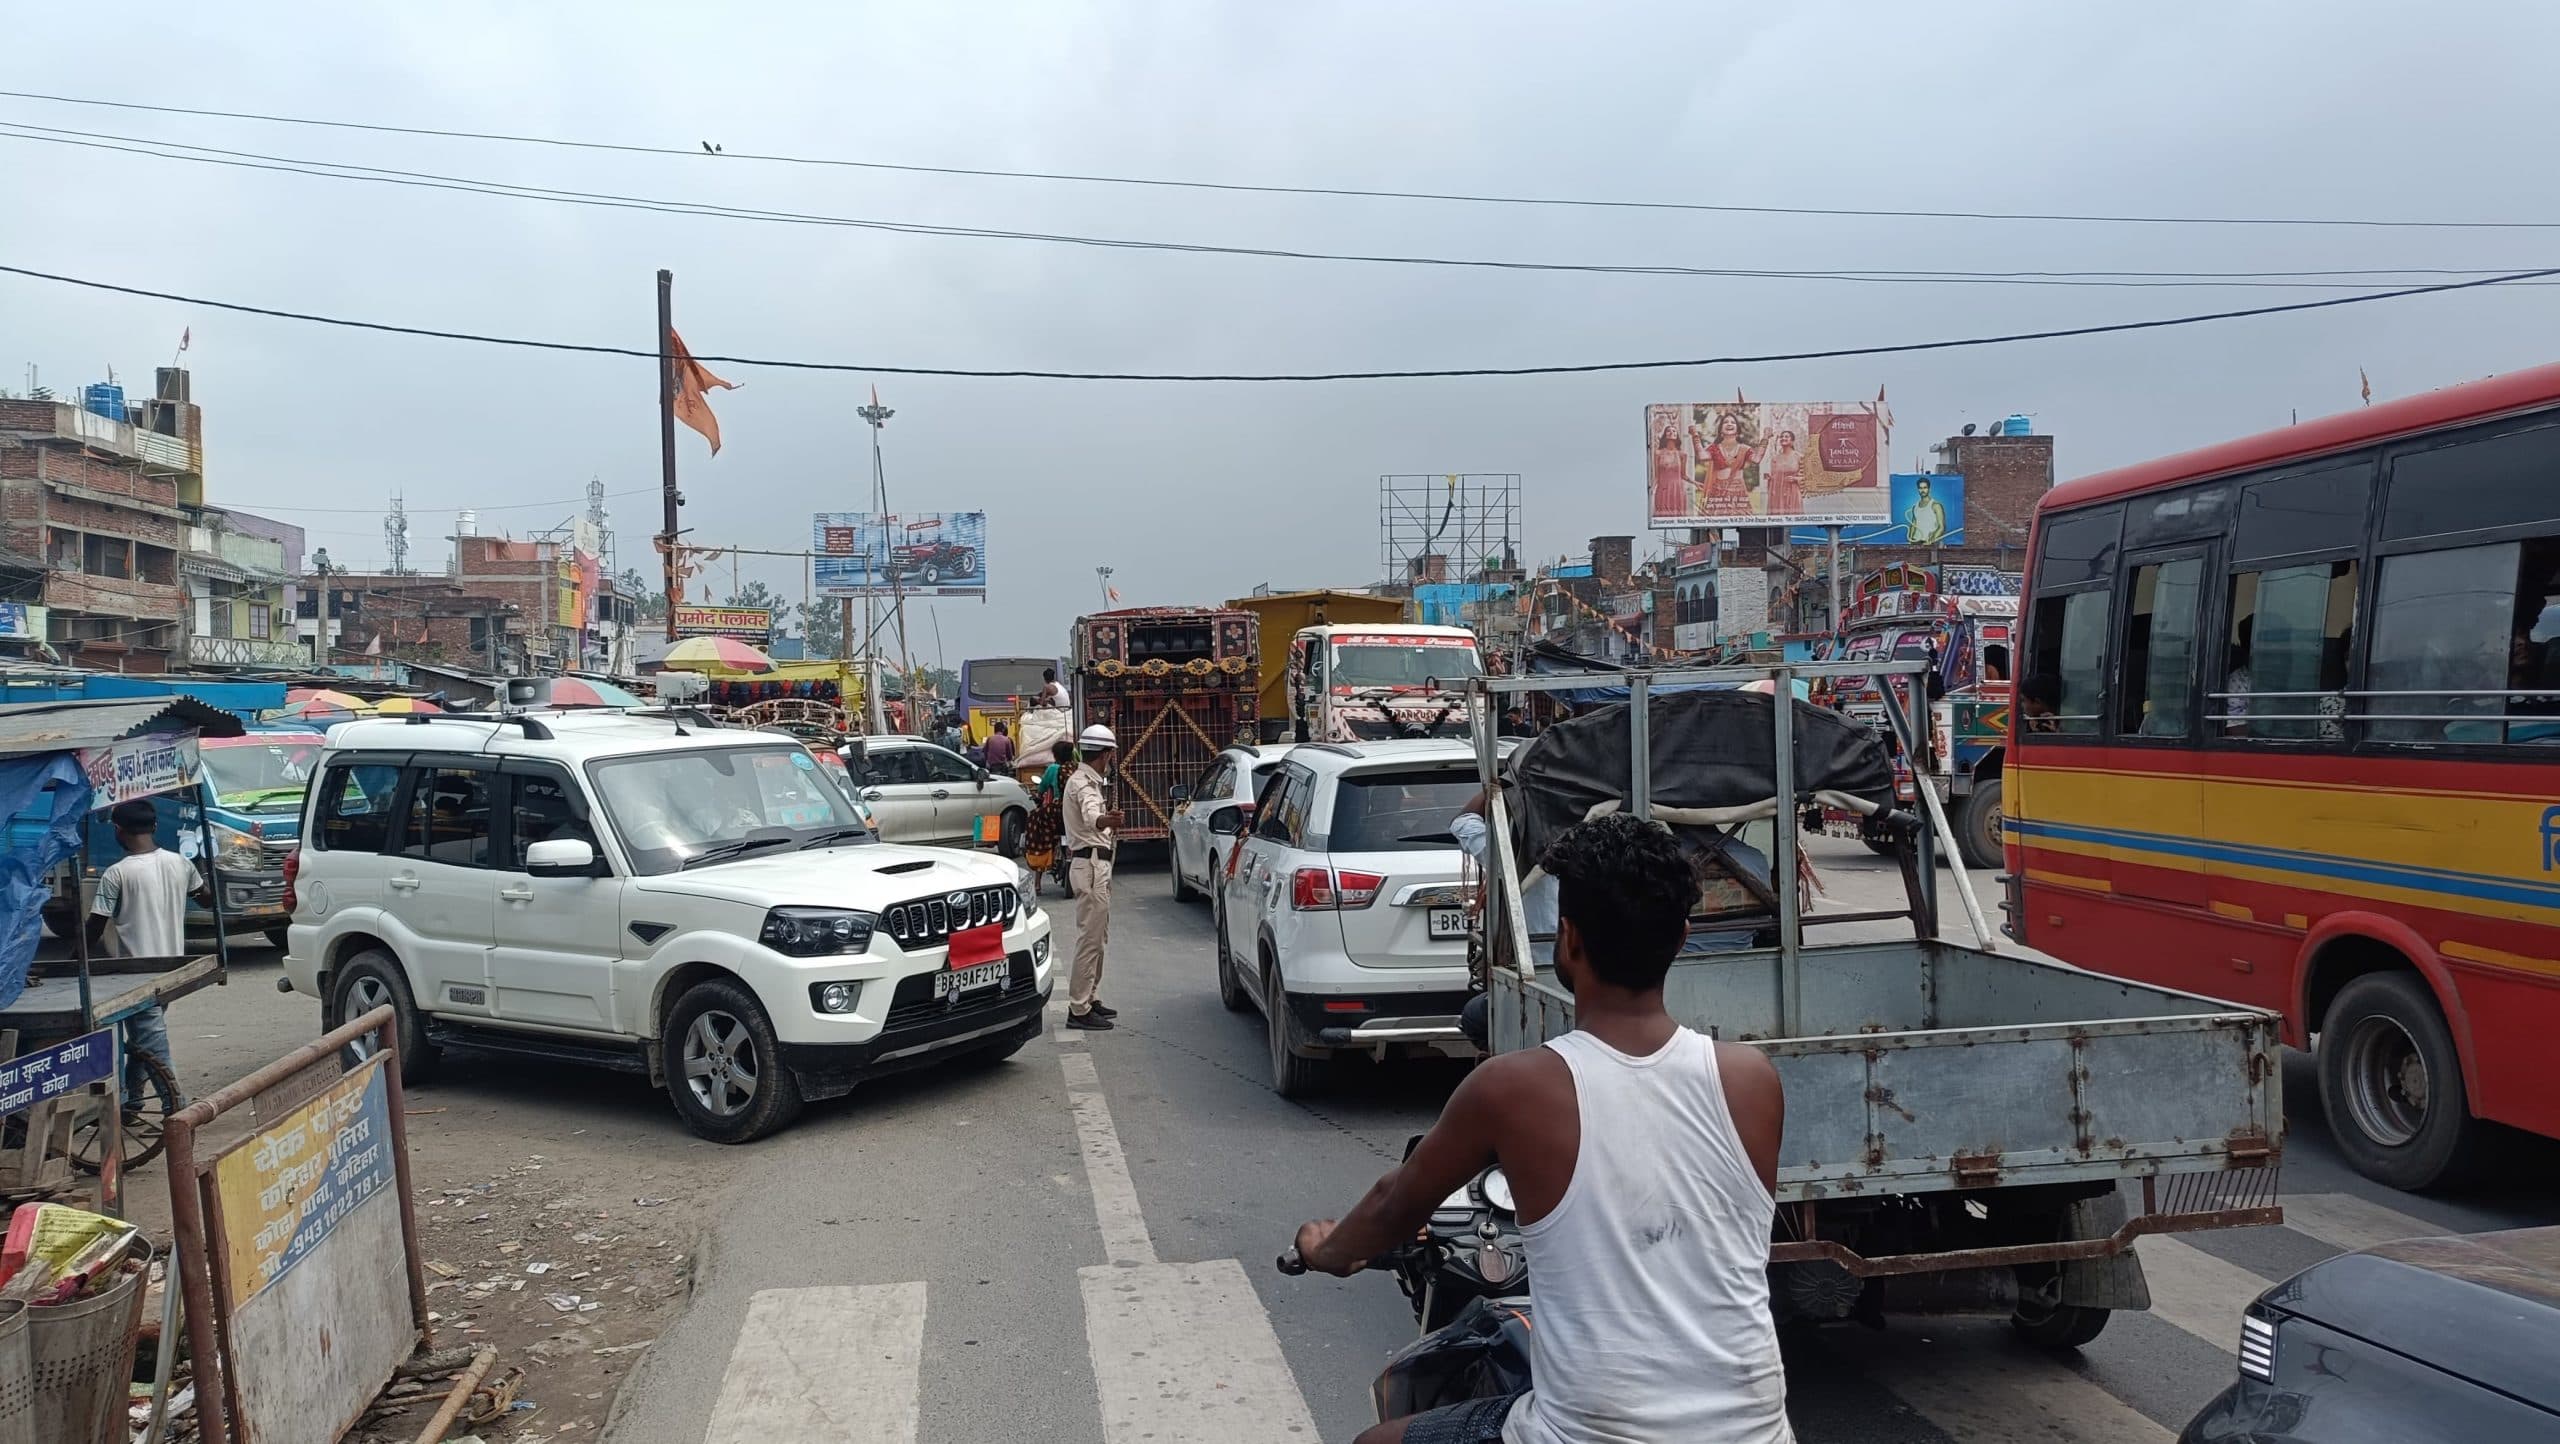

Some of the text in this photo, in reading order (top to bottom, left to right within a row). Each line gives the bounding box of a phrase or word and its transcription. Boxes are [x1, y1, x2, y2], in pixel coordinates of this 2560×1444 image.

[676, 609, 716, 626] प्रमोद
[941, 962, 1008, 992] BR39AF2121
[22, 1056, 53, 1084] सुन्दर
[42, 1072, 70, 1093] कोढ़ा
[257, 1117, 370, 1211] कटिहार पुलिस
[336, 1142, 380, 1186] कटिहार
